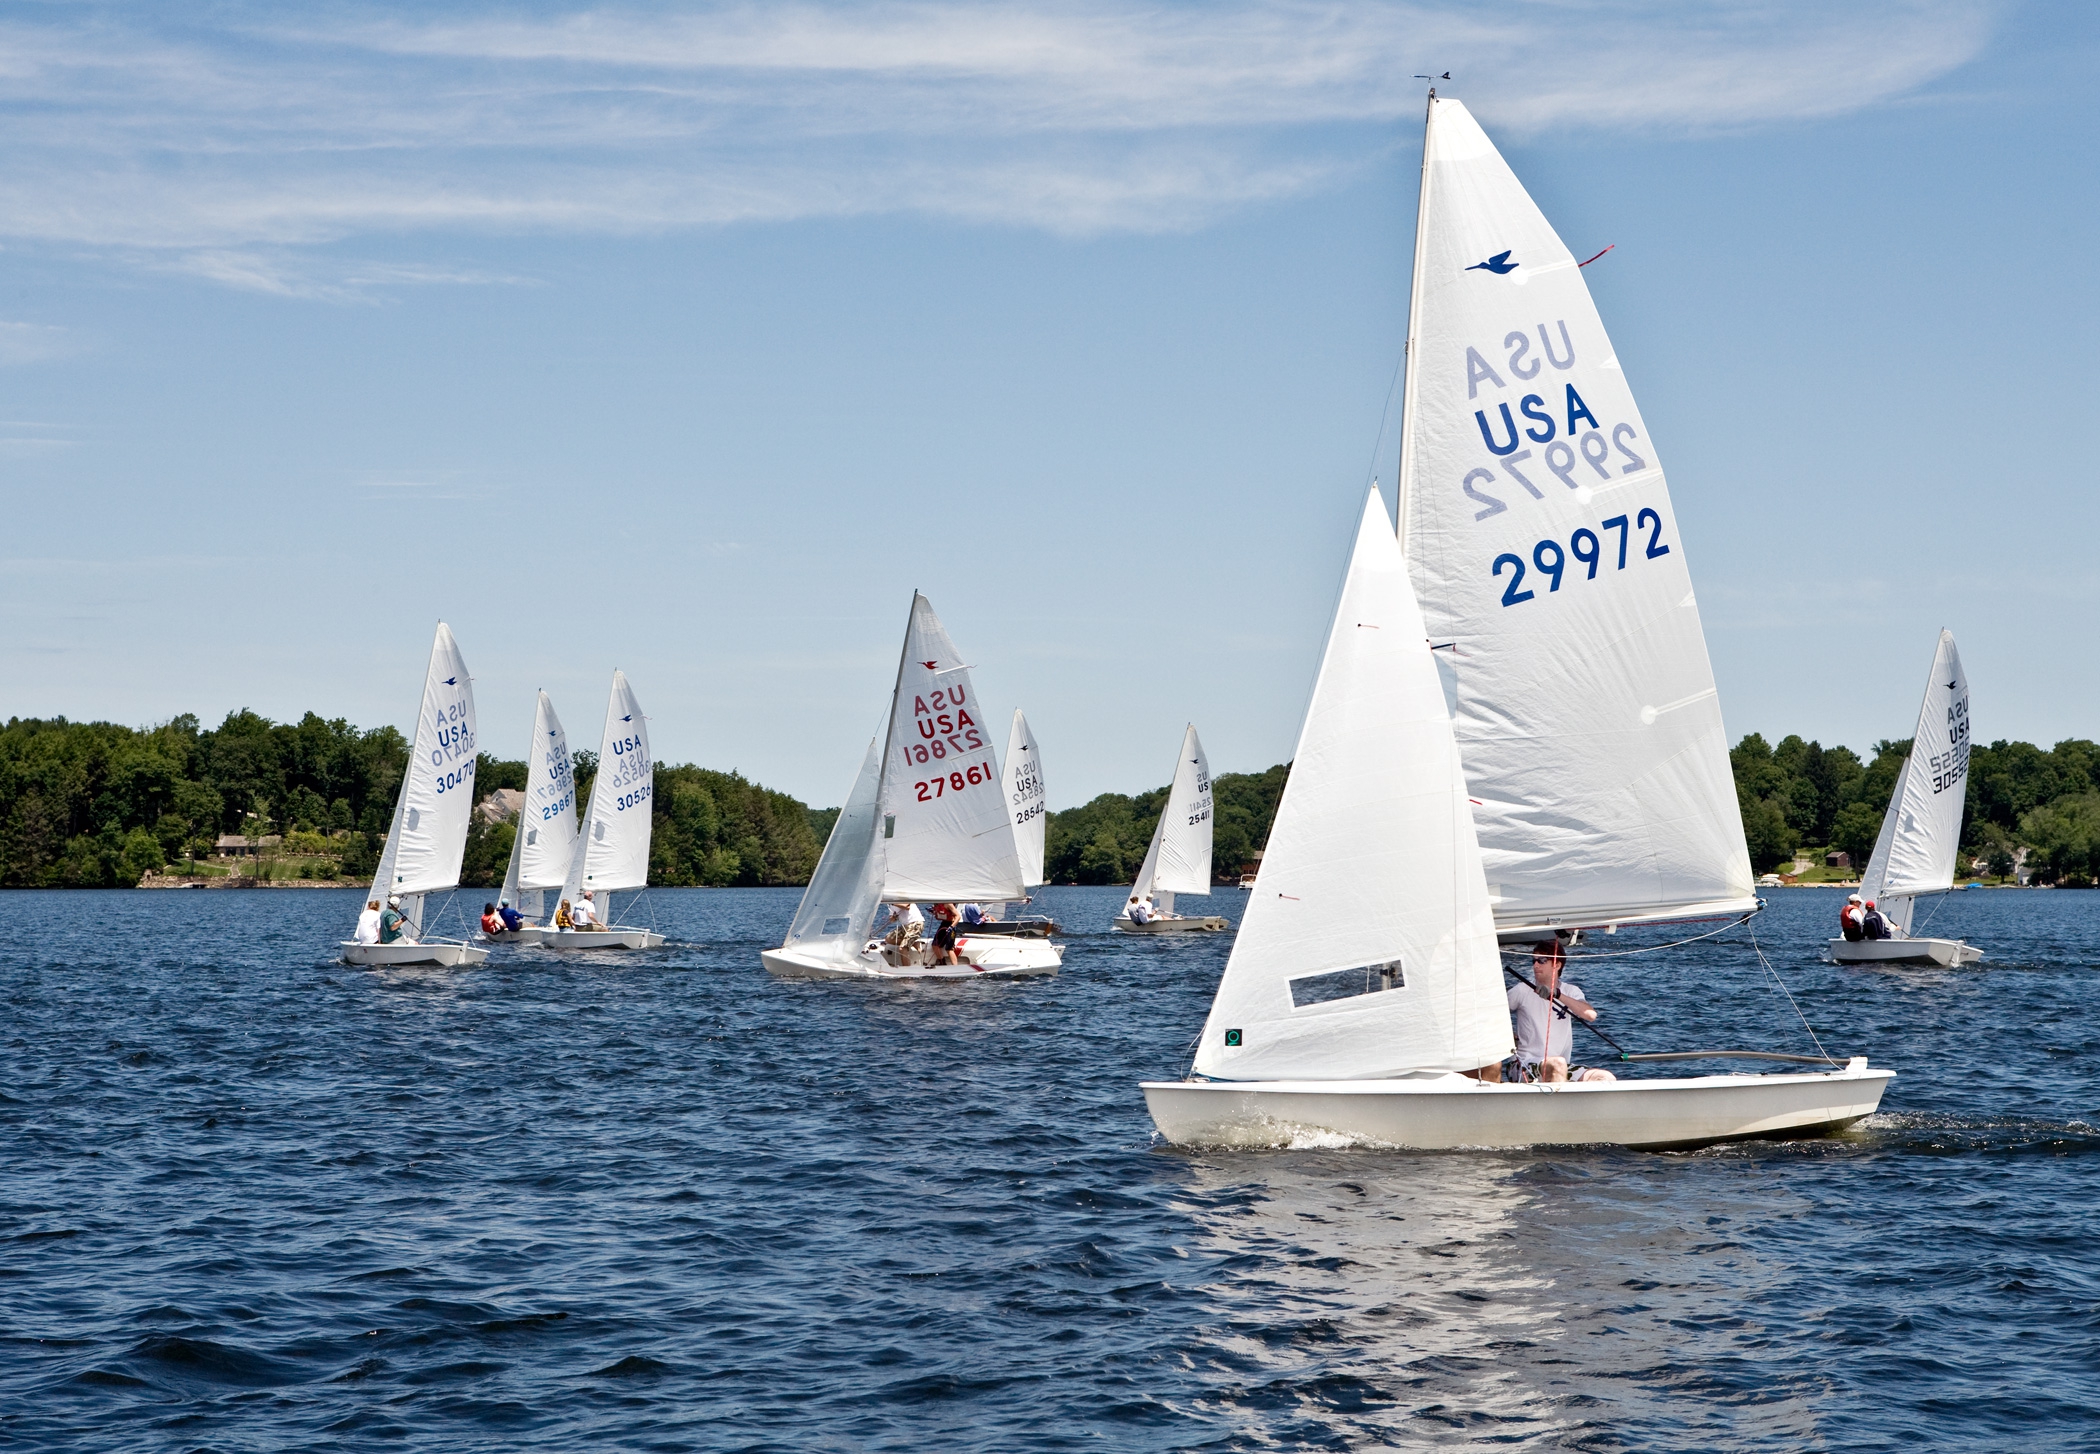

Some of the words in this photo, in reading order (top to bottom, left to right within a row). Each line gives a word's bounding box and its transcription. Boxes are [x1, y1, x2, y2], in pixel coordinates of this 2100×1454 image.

[1474, 382, 1600, 456] USA
[1492, 507, 1670, 608] 29972
[438, 721, 469, 747] USA
[917, 708, 975, 739] USA
[1949, 716, 1970, 745] USA
[612, 734, 642, 756] USA
[436, 758, 475, 794] 30470
[549, 758, 570, 780] USA
[914, 762, 992, 802] 27861
[1016, 775, 1038, 792] USA
[616, 782, 651, 812] 30526
[1198, 781, 1209, 793] US
[542, 790, 573, 821] 29867
[1016, 800, 1045, 825] 28542
[1188, 810, 1210, 826] 25411
